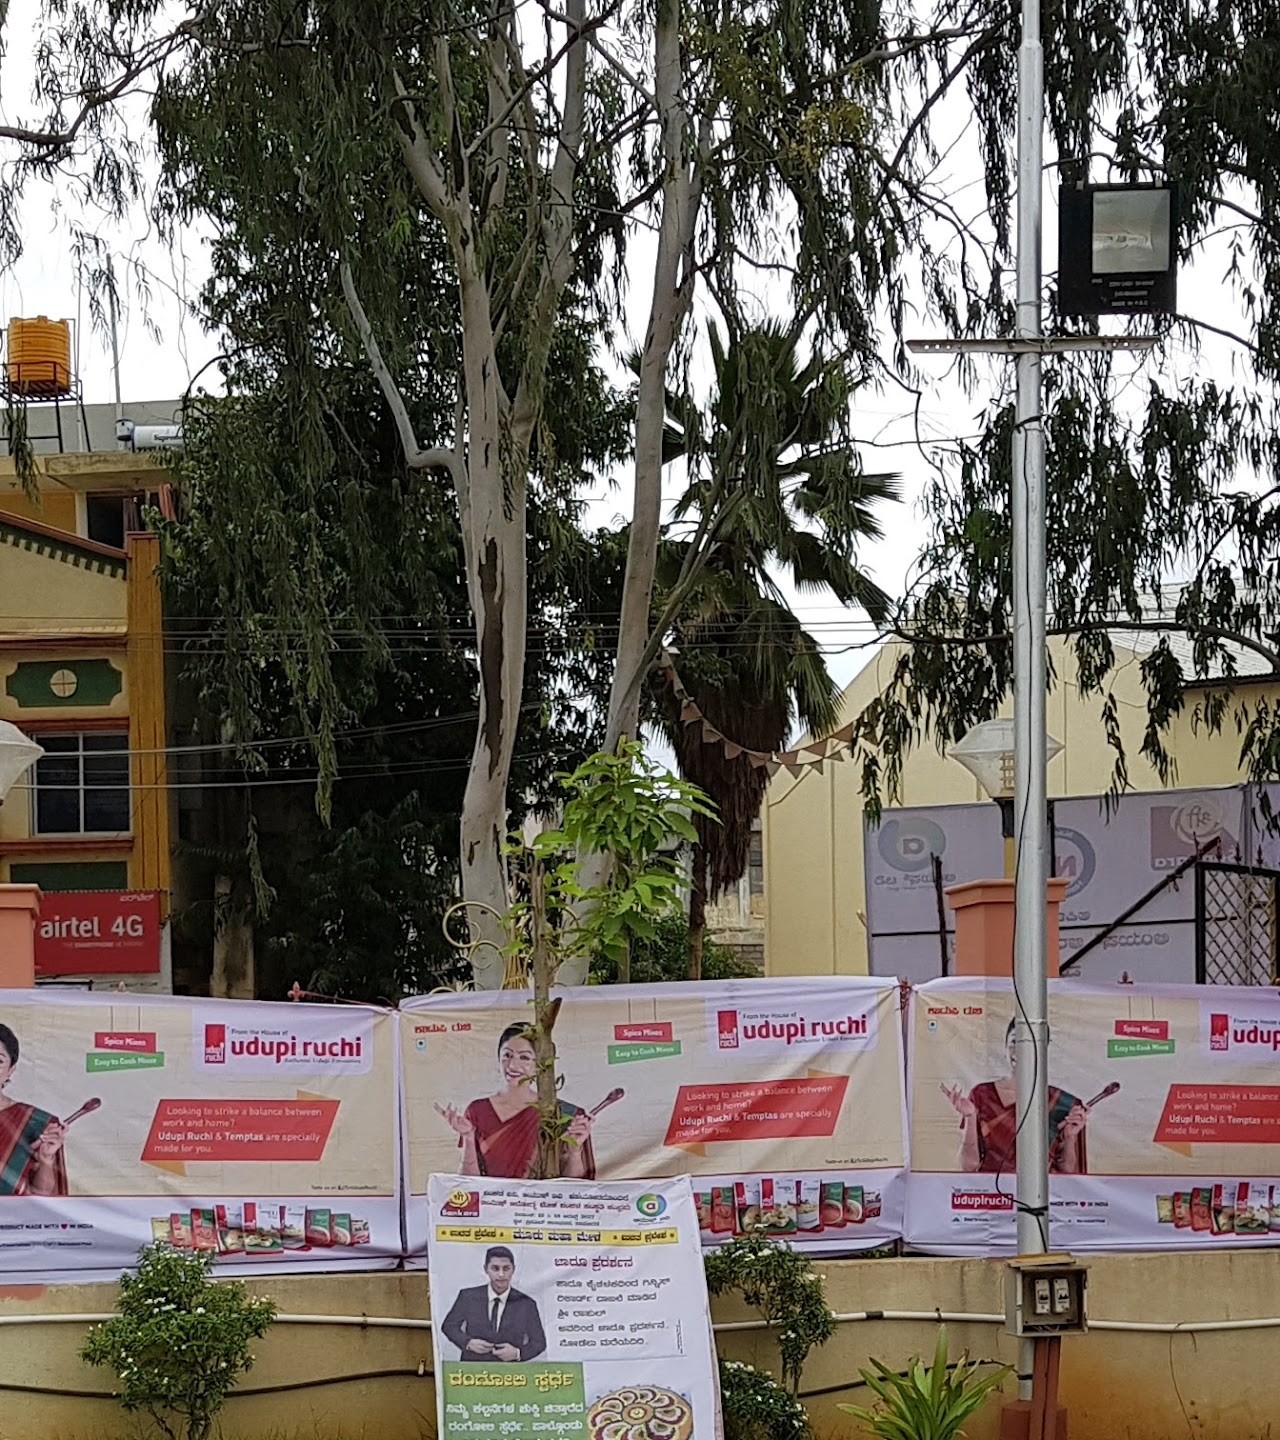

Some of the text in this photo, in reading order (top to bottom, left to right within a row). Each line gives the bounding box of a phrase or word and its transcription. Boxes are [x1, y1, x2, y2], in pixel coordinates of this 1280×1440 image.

[41, 915, 144, 938] airtel 4G
[743, 1014, 867, 1045] udupi ruchi
[231, 1036, 362, 1064] udupi ruchi
[686, 1091, 720, 1101] Looking
[721, 1091, 731, 1099] to
[731, 1089, 756, 1099] strike
[764, 1086, 796, 1096] balance
[797, 1085, 833, 1095] between
[1177, 1091, 1208, 1101] Looking
[1219, 1092, 1242, 1101] strike
[1249, 1092, 1280, 1101] balance
[683, 1099, 752, 1112] work and home?
[1173, 1103, 1192, 1111] work
[1193, 1103, 1210, 1111] and
[167, 1106, 202, 1118] Looking
[204, 1107, 213, 1116] to
[214, 1107, 240, 1116] strike
[249, 1106, 283, 1117] balance
[284, 1106, 322, 1117] between
[679, 1116, 706, 1127] Udupi
[706, 1113, 732, 1124] Ruchi
[742, 1110, 778, 1122] Temptas
[780, 1111, 794, 1120] are
[795, 1108, 832, 1120] specially
[162, 1118, 235, 1128] work and home?
[1169, 1115, 1193, 1125] Udupi
[1194, 1115, 1218, 1124] Ruchi
[1227, 1116, 1261, 1126] Temptas
[675, 1127, 700, 1138] made
[700, 1126, 713, 1135] for
[1165, 1127, 1188, 1135] made
[158, 1132, 186, 1143] Udupi
[187, 1132, 214, 1141] Ruchi
[225, 1132, 264, 1143] Temptas
[266, 1134, 280, 1142] are
[282, 1133, 321, 1144] specially
[154, 1144, 180, 1153] made
[181, 1143, 194, 1153] for
